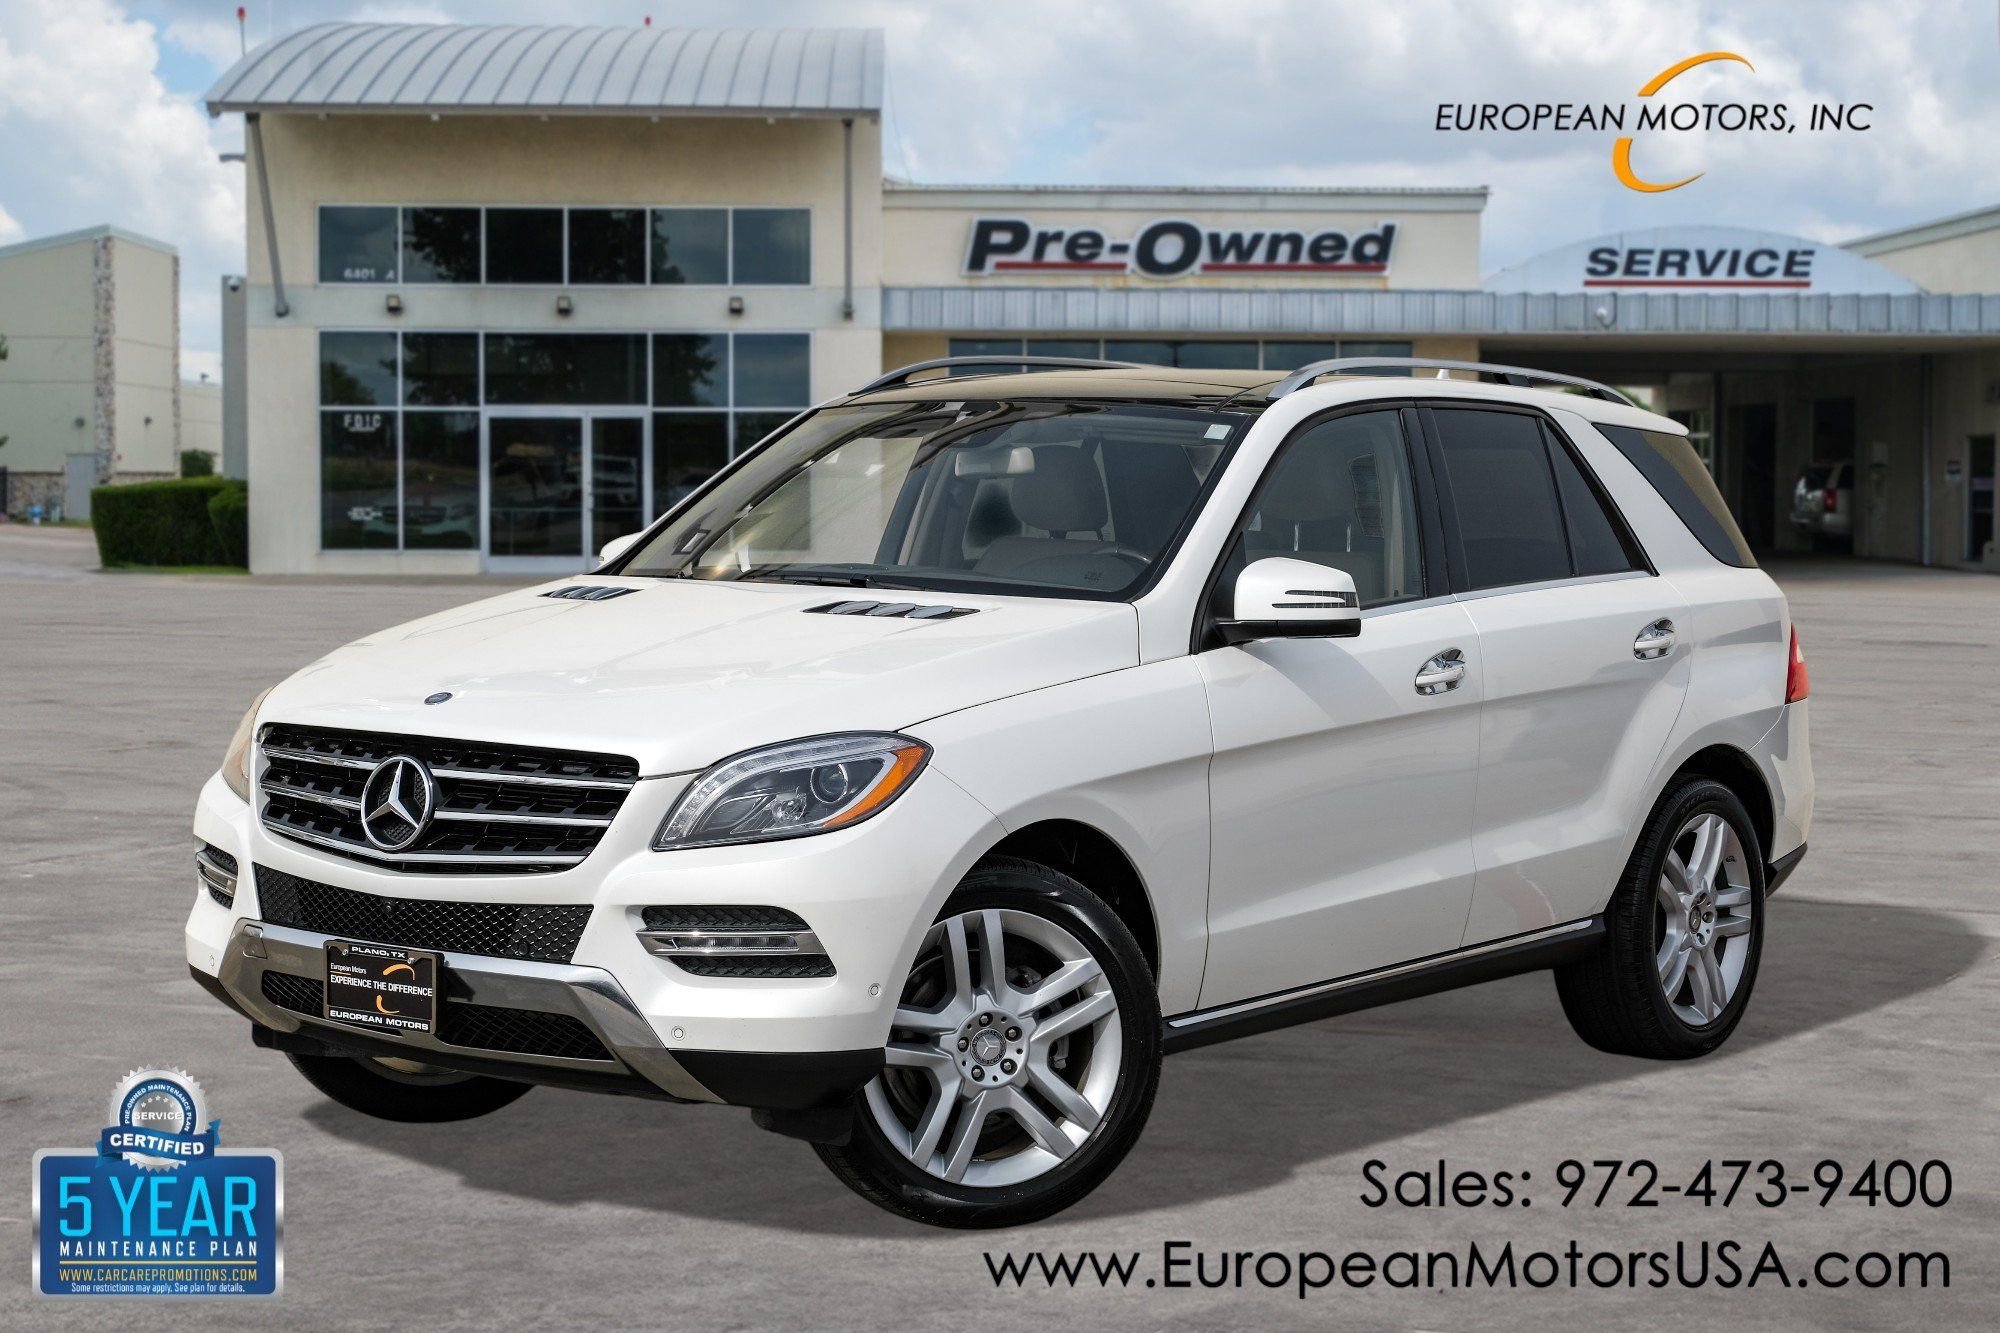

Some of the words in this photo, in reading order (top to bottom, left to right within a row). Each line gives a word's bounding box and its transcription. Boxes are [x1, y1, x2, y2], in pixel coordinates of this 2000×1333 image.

[967, 219, 1397, 275] Pre-Owned
[1585, 247, 1815, 277] SERVICE
[390, 951, 406, 959] TX
[330, 962, 352, 972] European
[330, 974, 372, 989] EXPERIENCE
[373, 980, 387, 991] THE
[388, 982, 433, 997] DIFFERENCE
[329, 1009, 383, 1024] EUROPEAN
[386, 1017, 429, 1031] MOTORS
